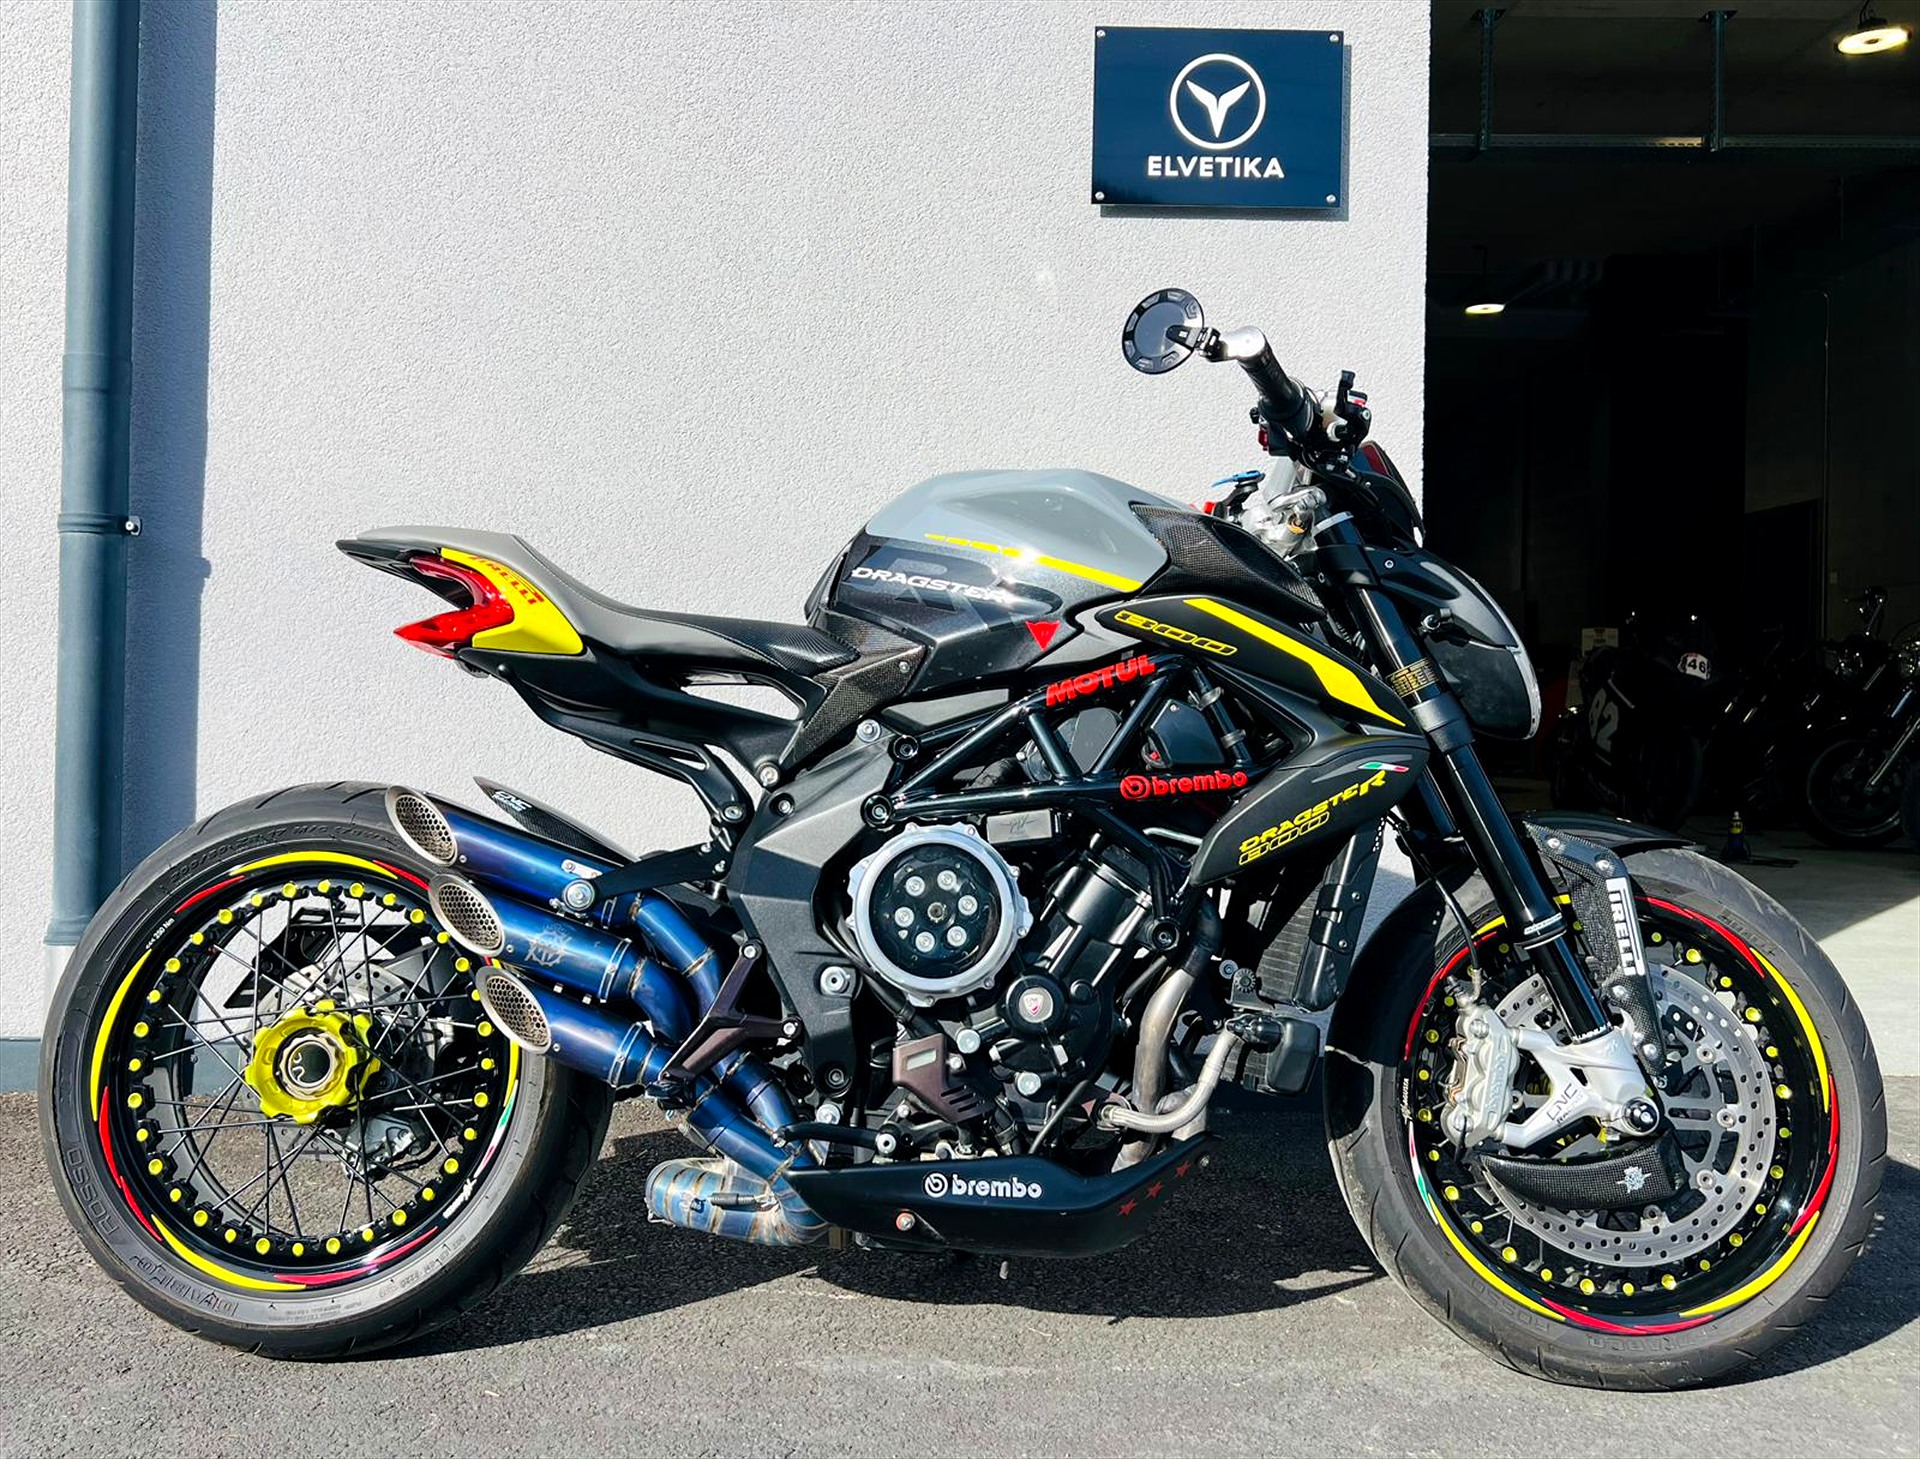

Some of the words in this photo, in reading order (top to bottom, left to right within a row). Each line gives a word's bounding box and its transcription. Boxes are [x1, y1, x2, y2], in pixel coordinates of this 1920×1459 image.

[1147, 155, 1285, 178] ELVETIKA
[851, 567, 1012, 604] DRAGSTER
[1114, 610, 1238, 656] 800
[1046, 654, 1156, 707] MOTUL
[1152, 770, 1248, 797] brembo
[1239, 811, 1330, 866] 800
[1606, 877, 1646, 976] PIRELLI
[67, 1148, 118, 1235] ROSSO
[952, 1174, 1042, 1199] brembo
